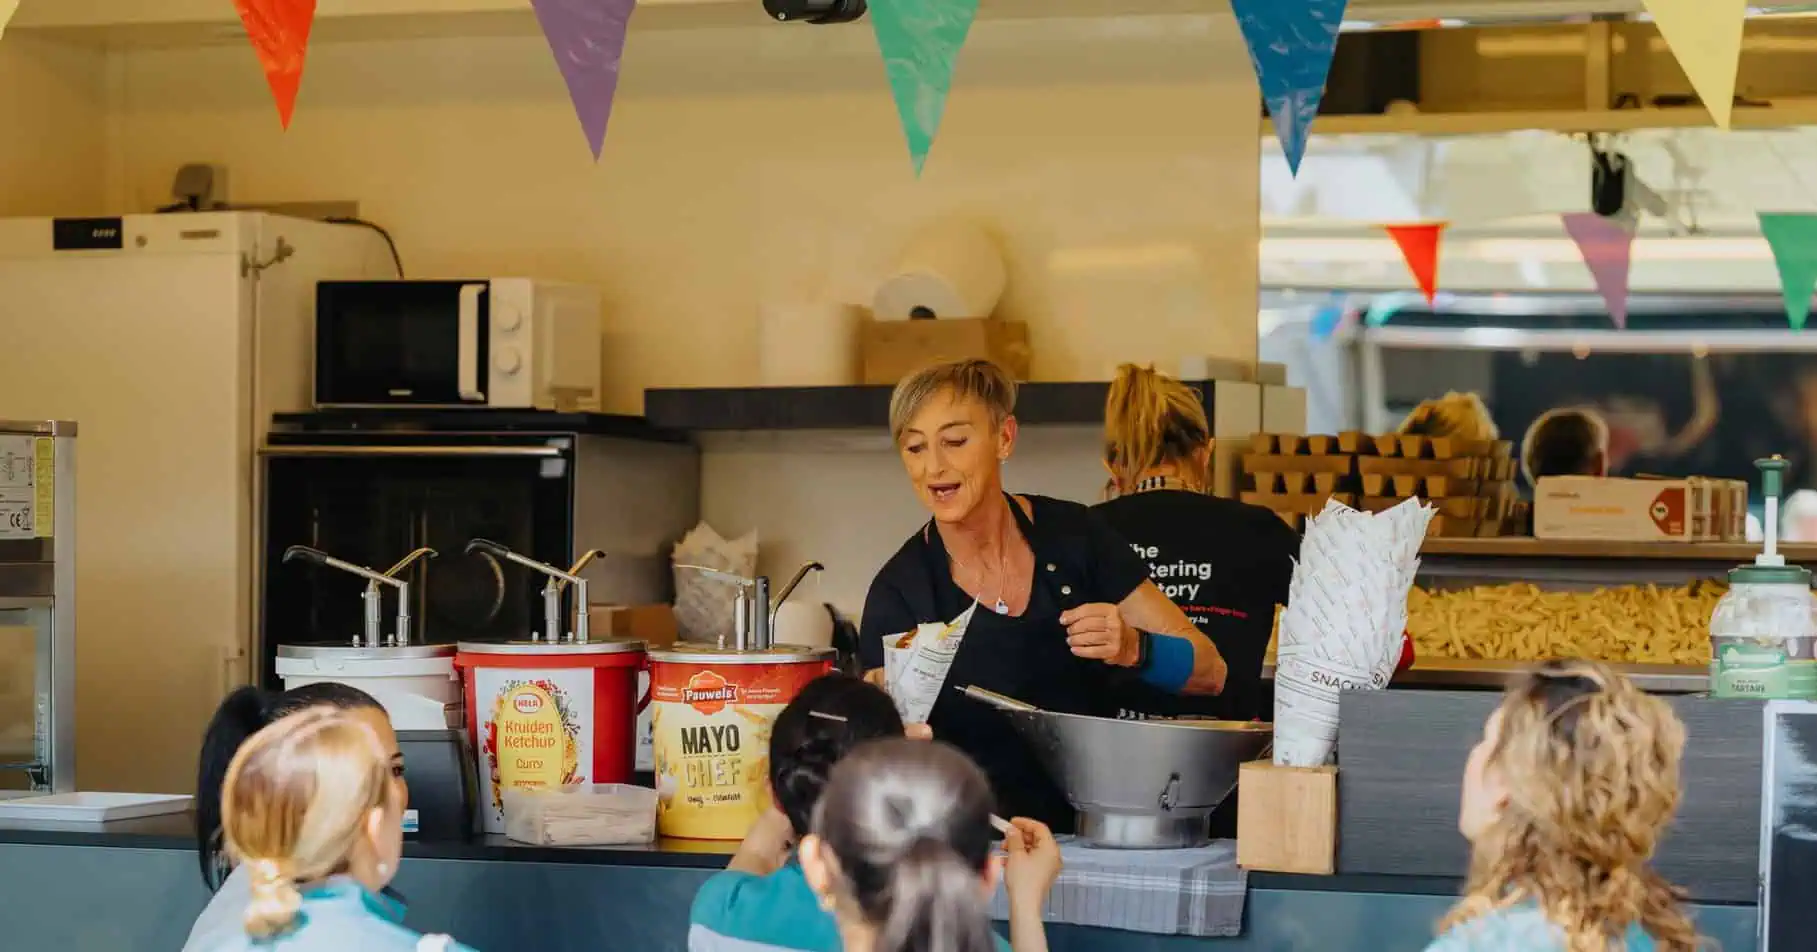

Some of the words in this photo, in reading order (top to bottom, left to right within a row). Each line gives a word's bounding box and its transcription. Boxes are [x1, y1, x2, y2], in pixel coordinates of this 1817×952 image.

[1129, 543, 1159, 559] he
[1149, 560, 1212, 580] tering
[685, 688, 732, 701] Pauwels
[518, 699, 538, 708] HELA
[505, 719, 553, 733] Kruiden
[504, 735, 556, 749] Ketchup
[681, 724, 741, 754] MAYO
[516, 758, 544, 770] Curry
[685, 758, 742, 789] CHEF
